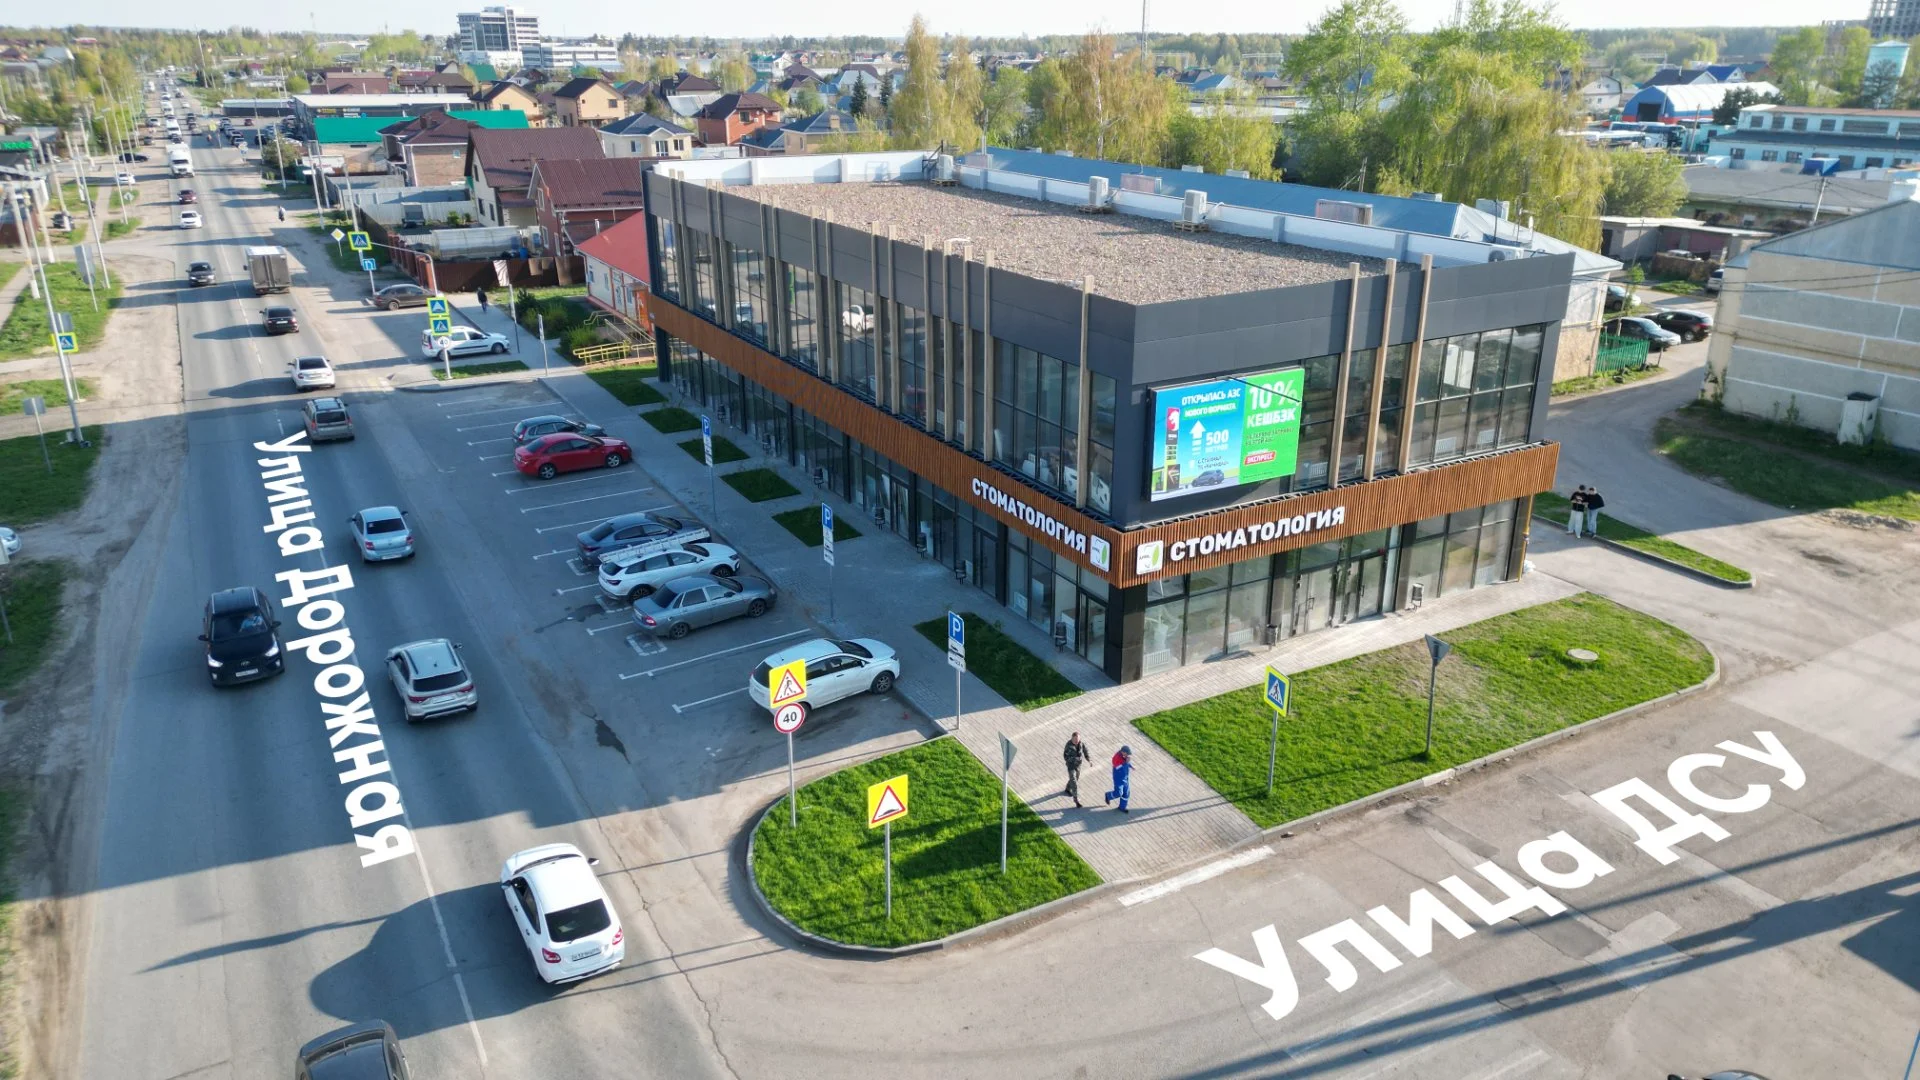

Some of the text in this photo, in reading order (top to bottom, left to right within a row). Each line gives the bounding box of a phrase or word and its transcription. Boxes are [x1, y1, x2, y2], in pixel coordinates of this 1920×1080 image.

[1181, 388, 1242, 406] ОТКРЫЛАСЬ АЗС
[1249, 379, 1301, 411] 10%
[1184, 402, 1237, 417] НОВОГО ФОРМАТА
[1246, 408, 1297, 428] КЕШБЭК
[1205, 429, 1230, 446] 500
[971, 477, 1086, 555] СТОМАТОЛОГИЯ
[1170, 506, 1345, 561] СТОМАТОЛОГИЯ
[782, 711, 797, 724] 40
